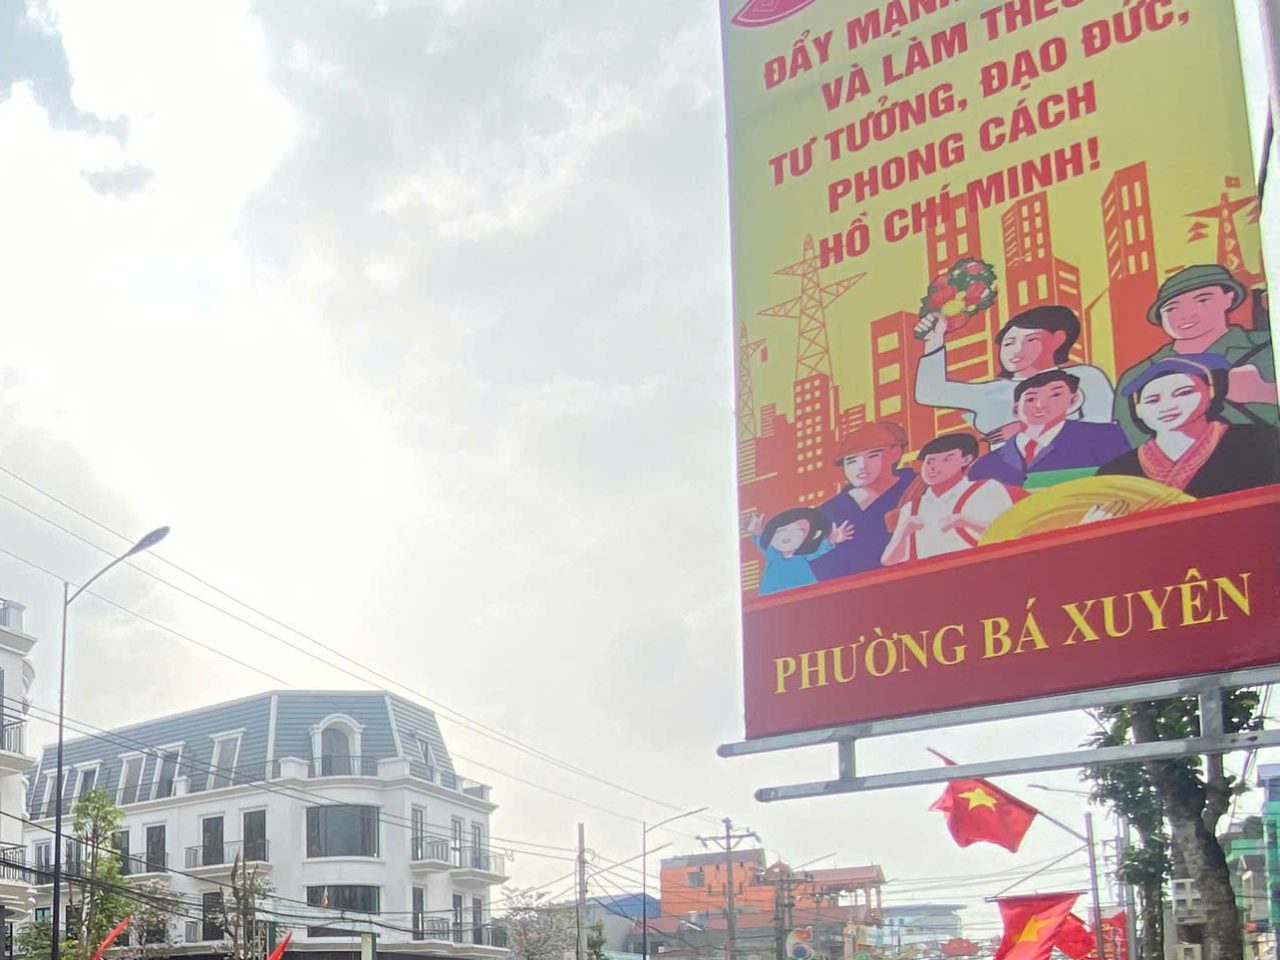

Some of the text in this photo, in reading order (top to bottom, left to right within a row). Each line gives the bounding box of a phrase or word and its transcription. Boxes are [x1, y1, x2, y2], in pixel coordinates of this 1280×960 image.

[764, 0, 959, 90] ĐẨY MẠN
[822, 0, 1085, 111] VÀ LÀM THE
[769, 136, 817, 185] TƯ
[824, 83, 967, 161] TƯỞNG,
[980, 37, 1067, 98] ĐẠO
[828, 79, 1097, 213] PHONG CÁCH
[820, 136, 1100, 269] HỒ CHÍ MINH!
[774, 567, 1253, 694] PHƯỜNG BÁ XUYÊN
